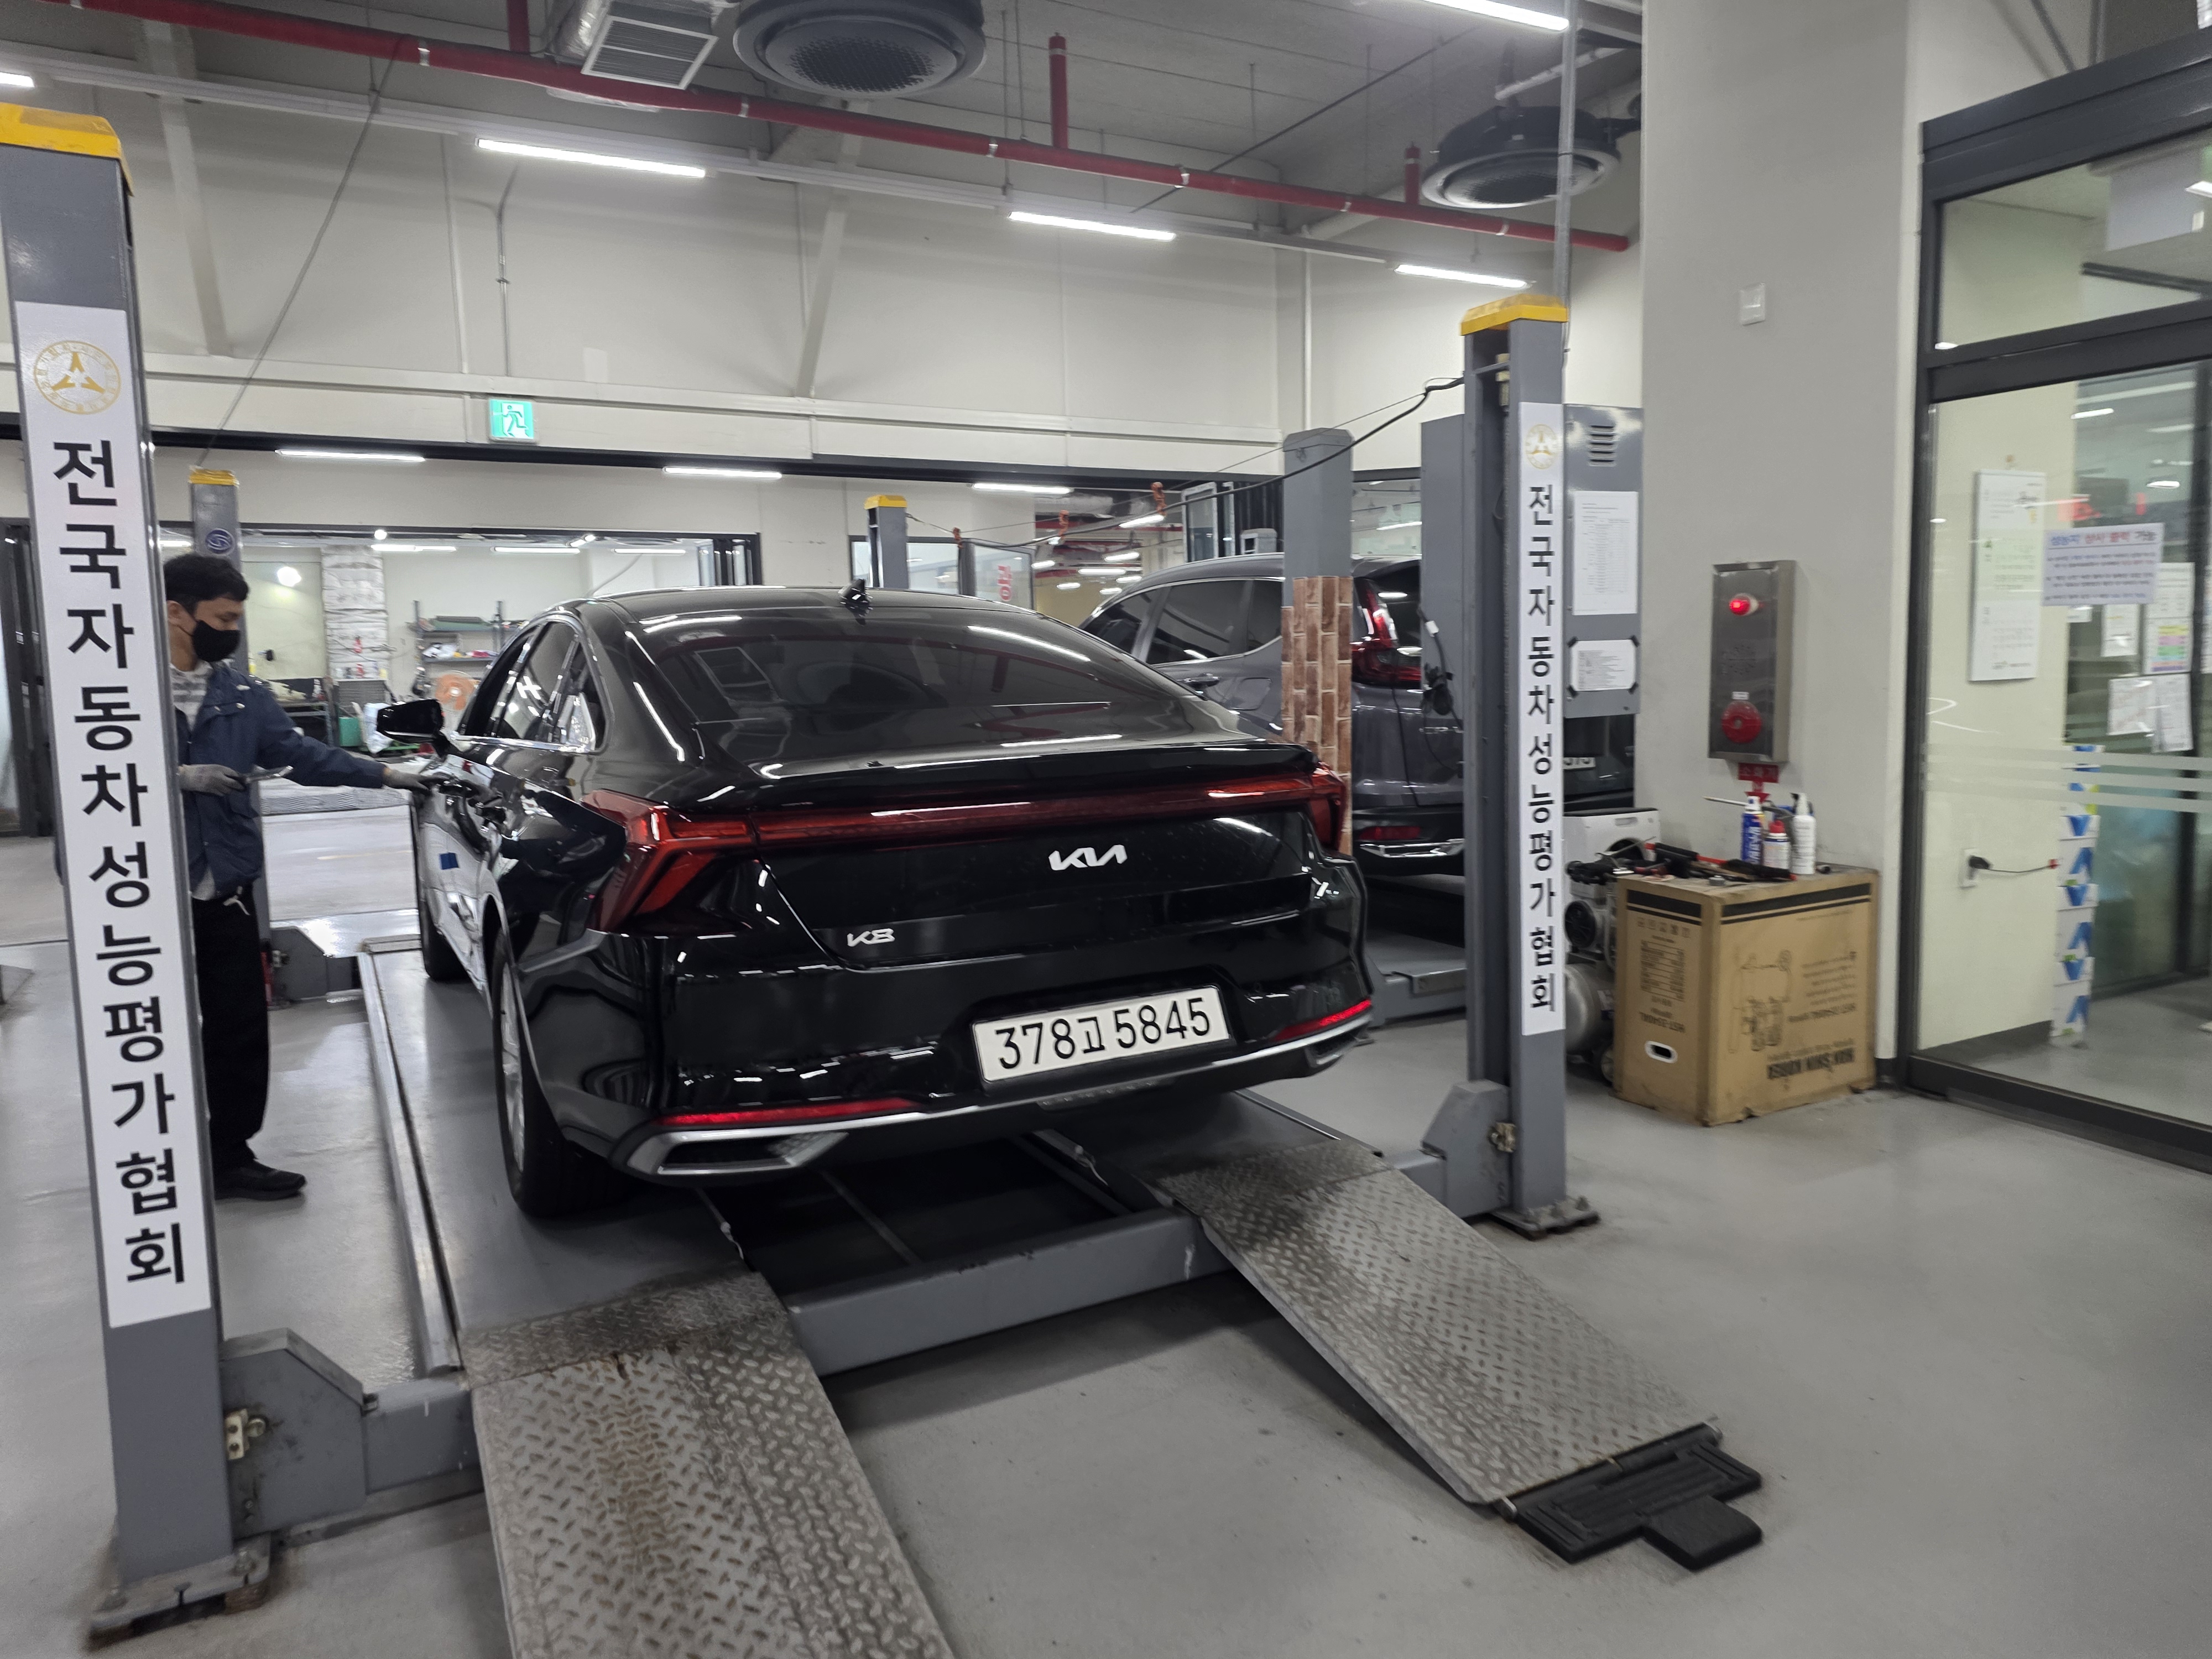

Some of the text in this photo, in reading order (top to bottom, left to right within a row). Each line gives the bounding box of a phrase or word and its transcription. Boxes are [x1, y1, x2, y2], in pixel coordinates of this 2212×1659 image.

[53, 440, 185, 1284] 전국자동차성능평가협회
[1528, 484, 1556, 1012] 전국자동차성능평가협회
[846, 928, 895, 947] K8
[1113, 997, 1210, 1048] 5845
